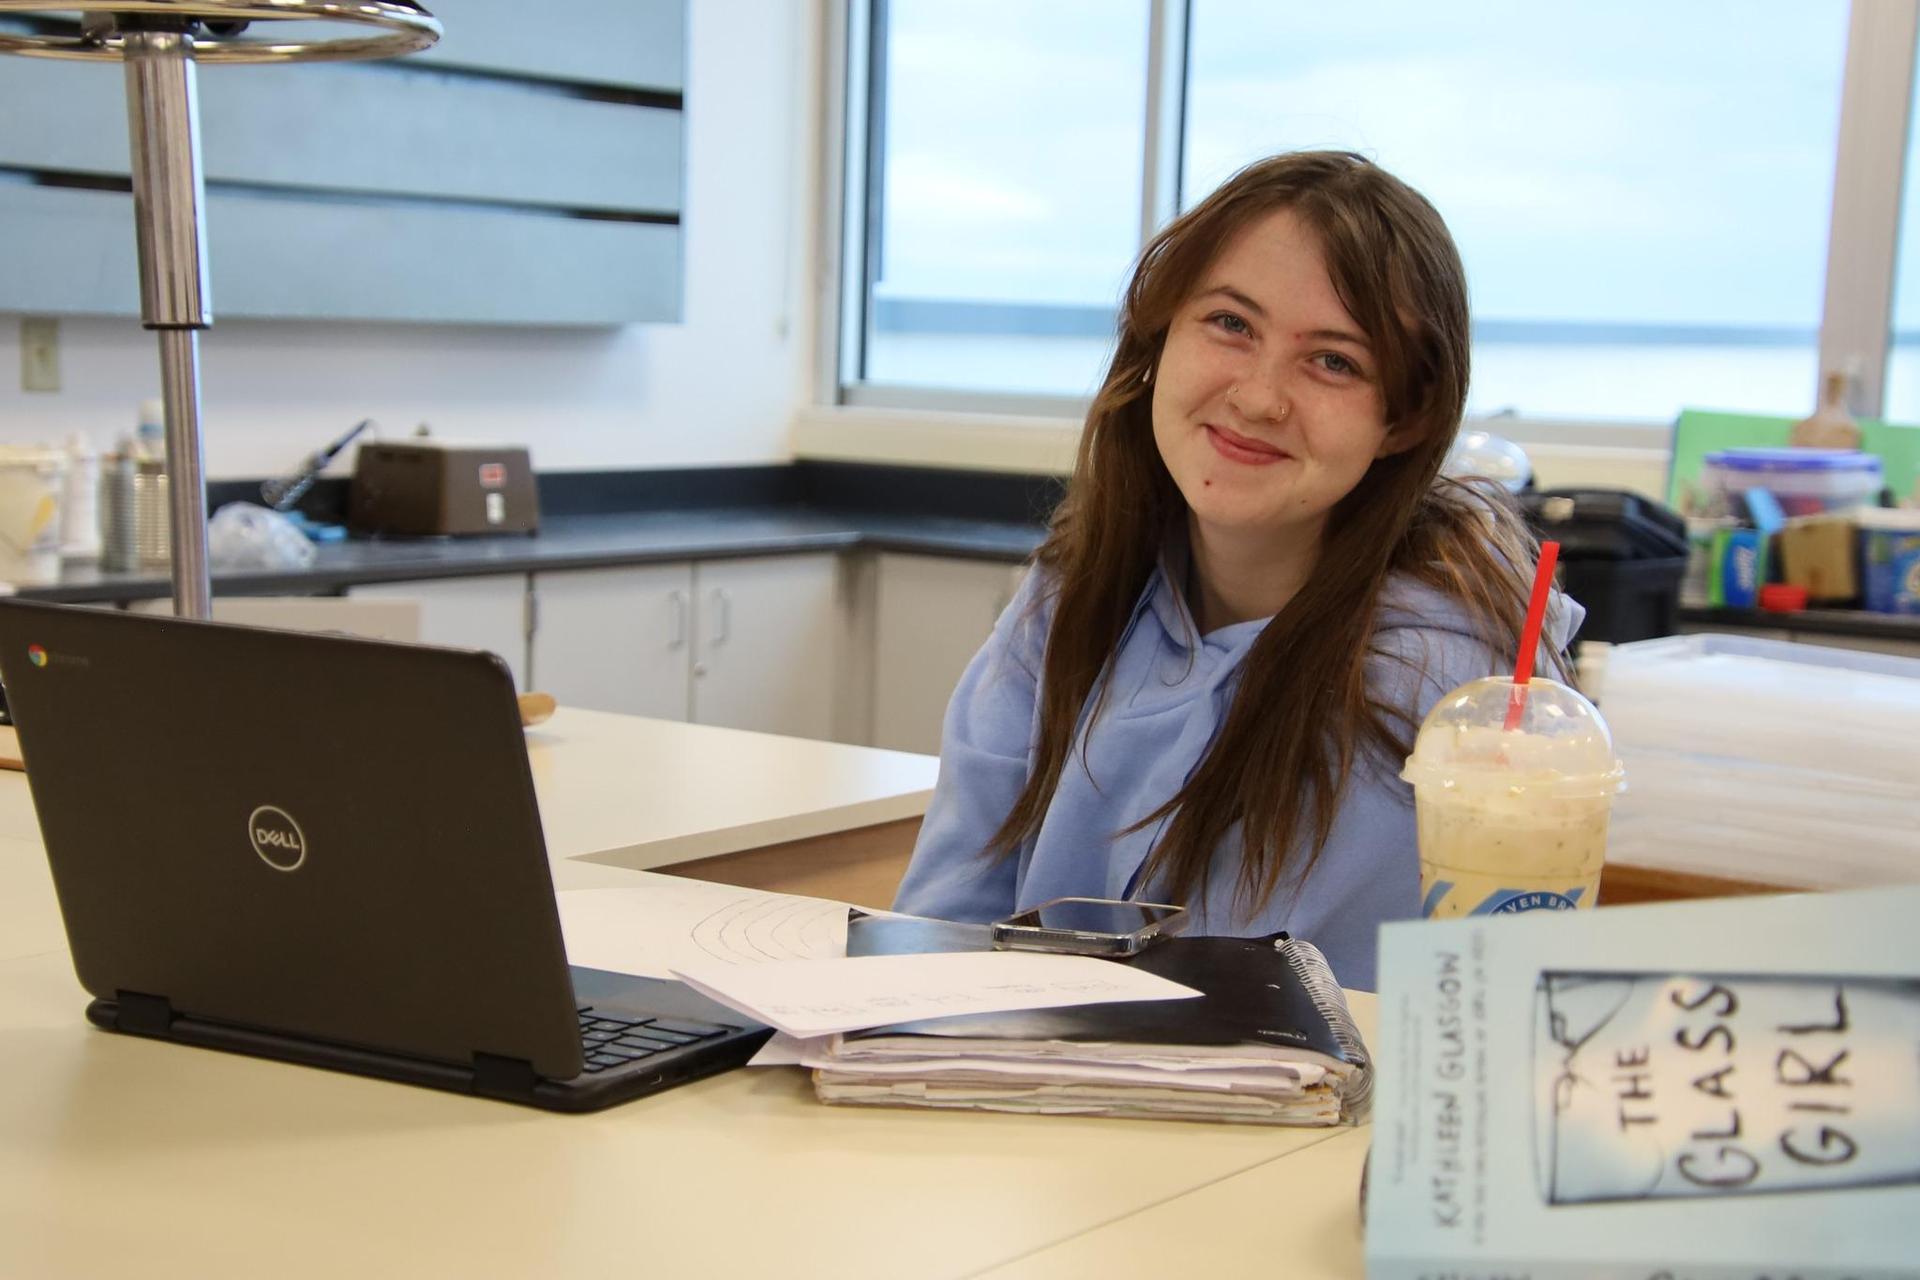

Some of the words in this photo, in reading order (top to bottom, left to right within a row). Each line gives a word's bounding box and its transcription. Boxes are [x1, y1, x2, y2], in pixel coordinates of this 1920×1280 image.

[256, 828, 300, 849] DELL
[1499, 894, 1542, 913] VEN
[1434, 950, 1466, 1081] GLASGOW
[1612, 1044, 1659, 1132] THE
[1671, 983, 1761, 1187] GLASS
[1775, 984, 1860, 1167] GIRL
